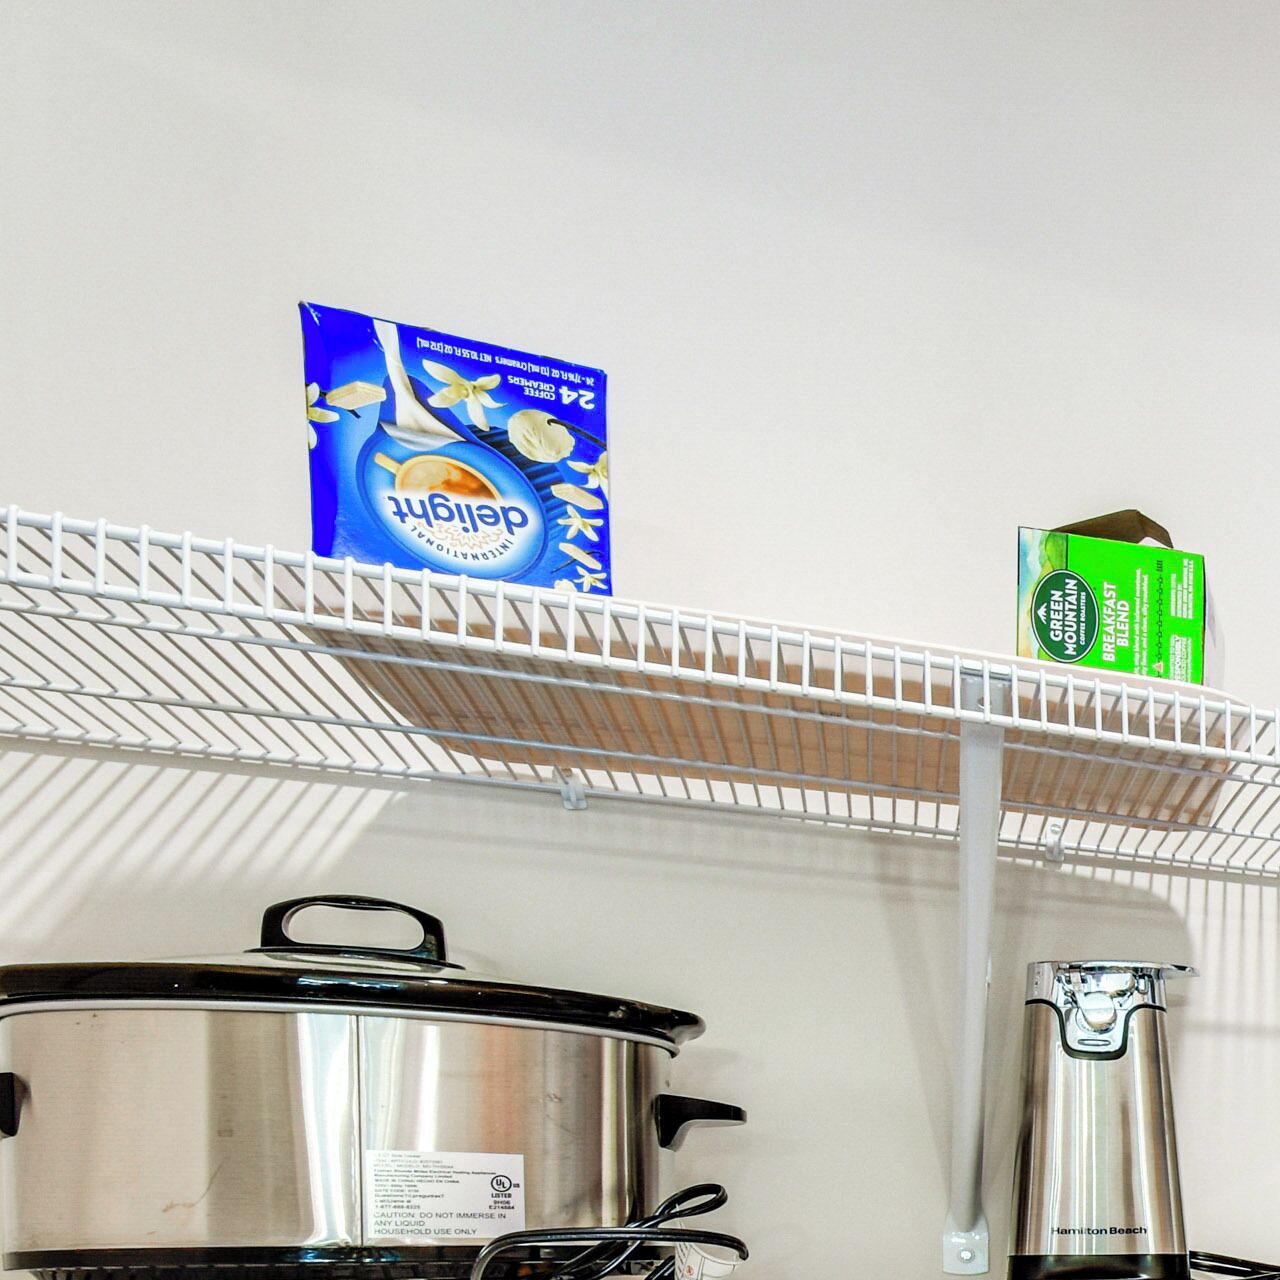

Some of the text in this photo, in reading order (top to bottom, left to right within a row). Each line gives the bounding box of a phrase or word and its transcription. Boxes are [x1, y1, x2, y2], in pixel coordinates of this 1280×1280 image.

[495, 356, 528, 372] Creamers
[507, 375, 556, 392] CREAMERS
[523, 386, 556, 401] COFFEE
[559, 385, 596, 410] 24
[387, 492, 529, 536] delight
[410, 524, 515, 561] INTERNATIONAL
[1050, 589, 1064, 642] GREEN
[1063, 578, 1078, 656] MOUNTAIN
[1079, 591, 1087, 646] COFFEE ROASTERS
[1102, 581, 1117, 662] BREAKFAST
[1116, 599, 1130, 647] BLEND
[374, 1219, 425, 1227] ANY LIQUID
[419, 1211, 433, 1219] DO
[456, 1212, 496, 1220] IMMERSE
[374, 1227, 432, 1235] HOUSEHOLD
[454, 1228, 478, 1236] ONLY
[1109, 1226, 1148, 1235] Beach
